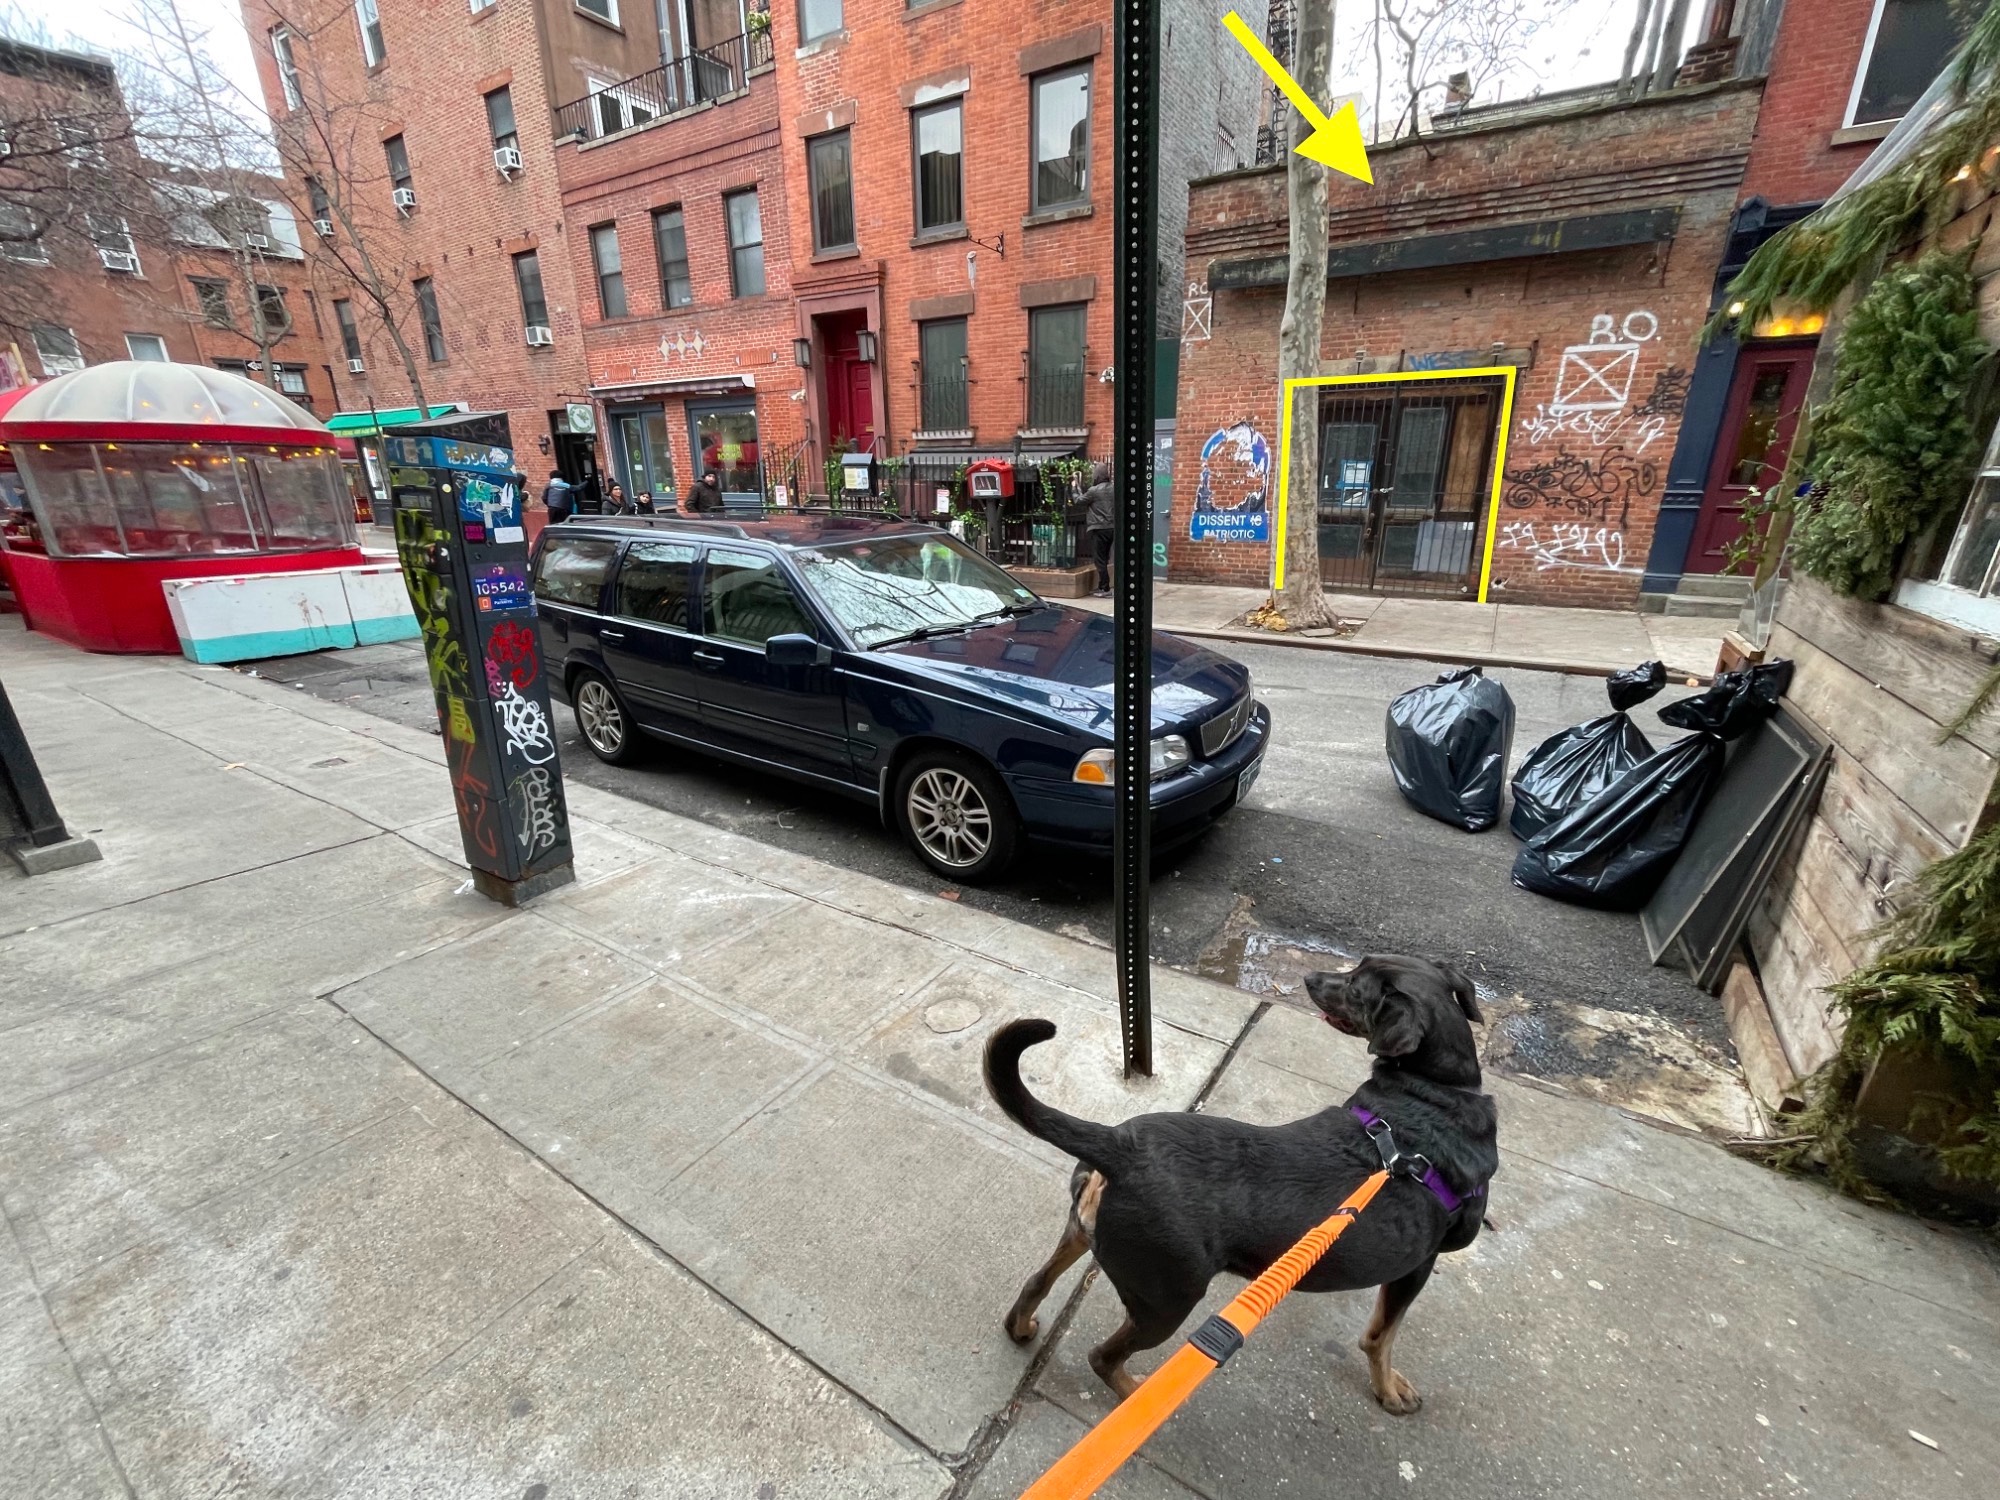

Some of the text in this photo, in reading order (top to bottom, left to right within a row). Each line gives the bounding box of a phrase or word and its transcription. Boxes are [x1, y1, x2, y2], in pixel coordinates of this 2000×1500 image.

[1199, 514, 1246, 527] DISSENT
[1203, 529, 1255, 539] PATRIOTIC
[476, 580, 525, 596] 105542
